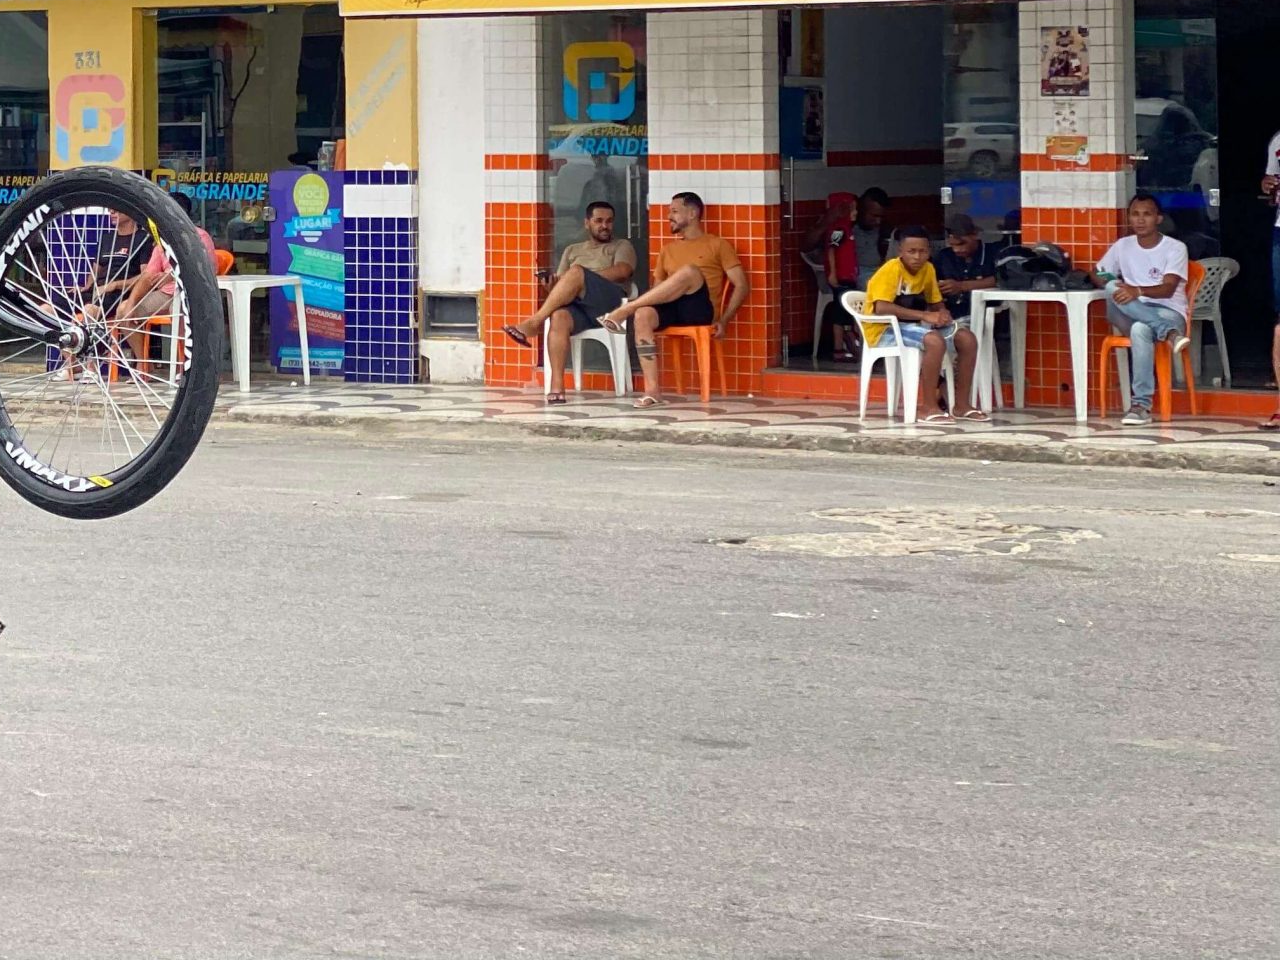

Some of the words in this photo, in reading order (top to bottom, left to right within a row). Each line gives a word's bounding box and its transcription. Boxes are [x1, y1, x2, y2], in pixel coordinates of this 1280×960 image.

[74, 51, 102, 69] 331
[5, 176, 10, 186] E
[178, 169, 214, 183] GRÁFICA
[217, 172, 221, 183] E
[223, 171, 268, 183] PAPELARIA
[195, 183, 267, 200] GRANDE
[294, 216, 331, 230] LUGAR!
[306, 307, 342, 321] COPIADORA
[5, 441, 97, 492] VMAXX
